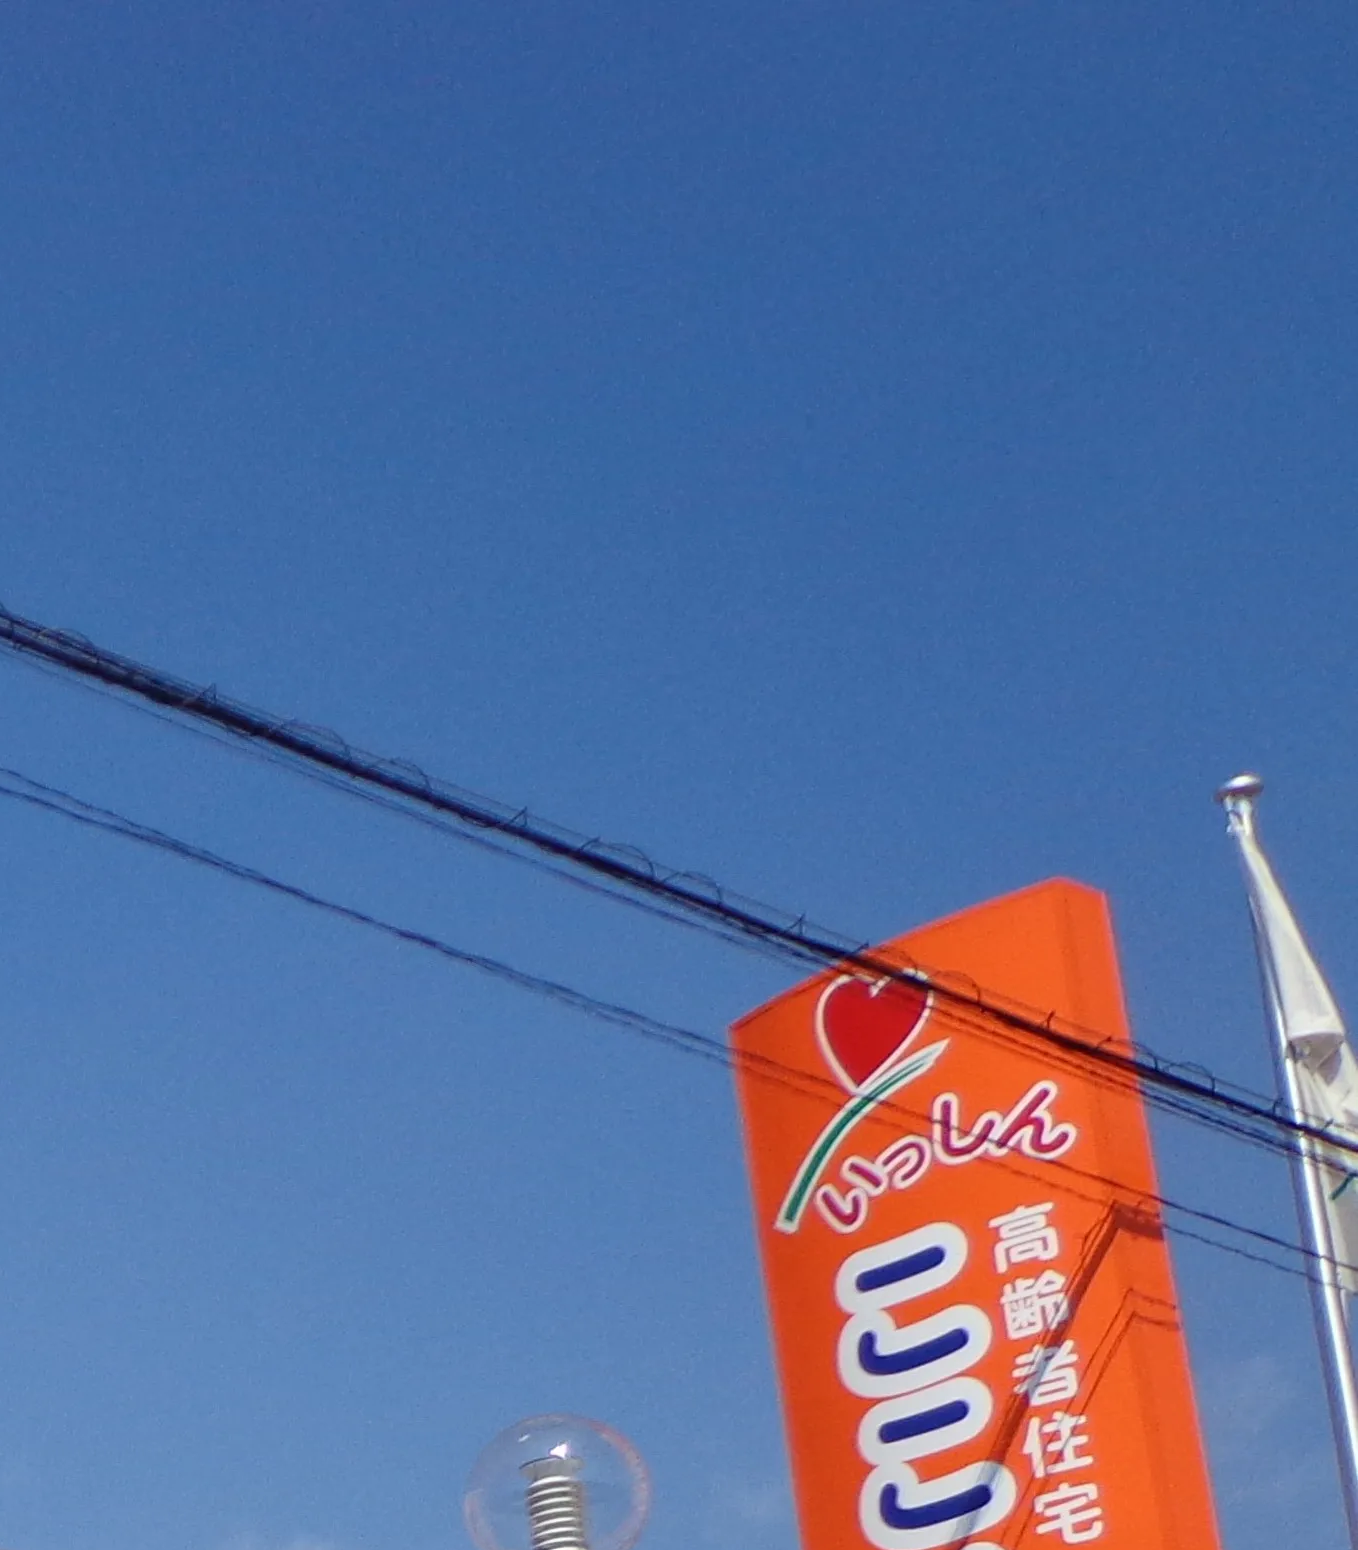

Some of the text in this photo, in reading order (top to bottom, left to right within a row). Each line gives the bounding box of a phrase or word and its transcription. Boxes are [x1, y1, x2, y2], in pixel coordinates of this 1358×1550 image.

[817, 1081, 1077, 1233] いっしん
[988, 1200, 1105, 1545] 高齢者住宅
